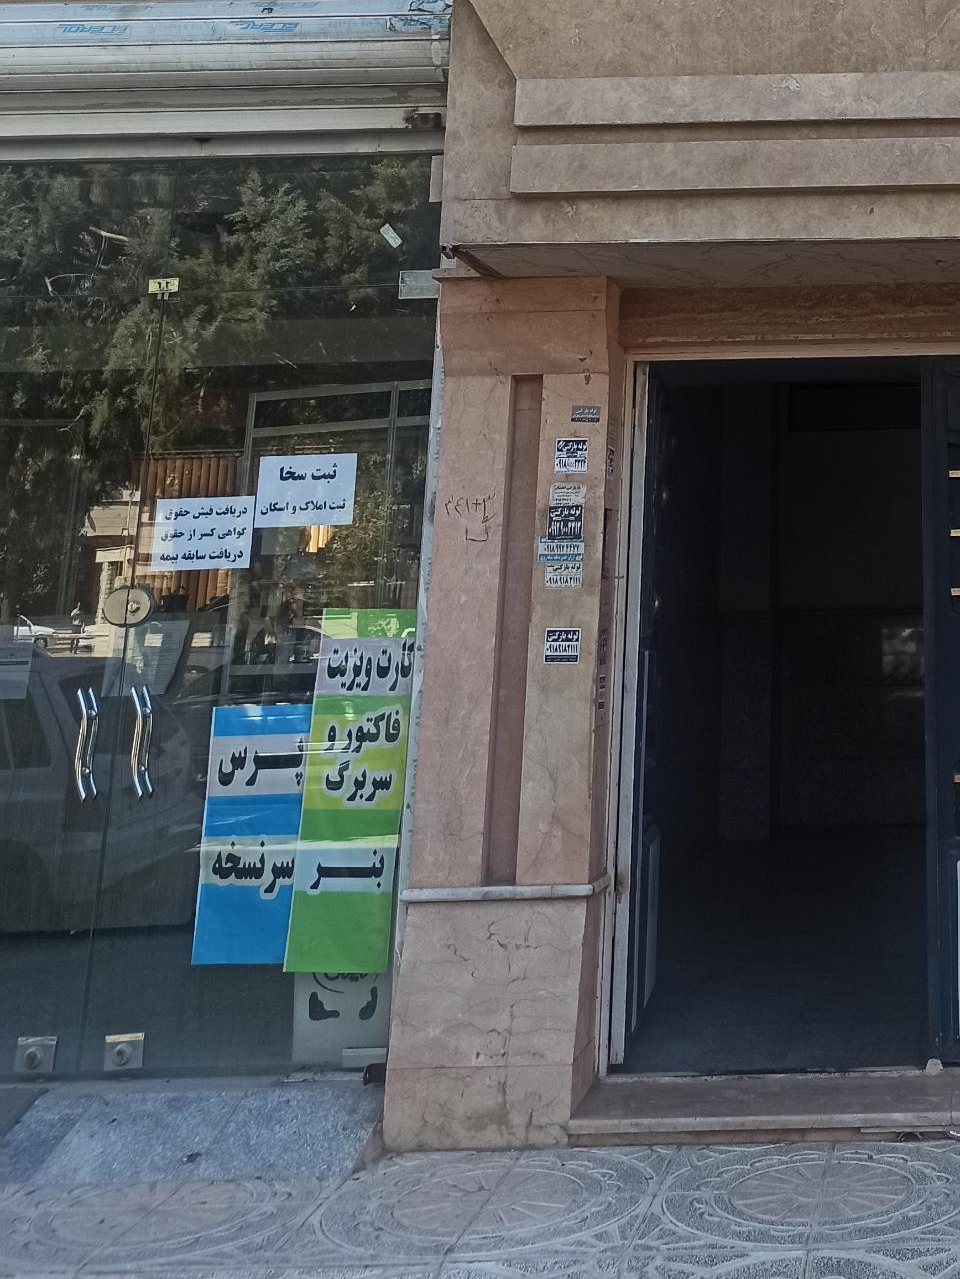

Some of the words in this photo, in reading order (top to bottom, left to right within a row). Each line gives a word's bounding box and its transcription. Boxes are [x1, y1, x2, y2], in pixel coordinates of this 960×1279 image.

[279, 465, 307, 482] سخا
[311, 462, 338, 484] ثبت
[192, 505, 214, 519] فیش
[215, 504, 248, 518] دریافت
[260, 501, 289, 516] اسکان
[290, 504, 297, 515] و
[299, 500, 327, 511] املاک
[328, 498, 347, 512] ثبت
[164, 507, 191, 521] حقوق
[160, 528, 185, 542] حقوق
[187, 527, 196, 541] از
[197, 527, 216, 541] کسر
[159, 552, 179, 564] بیمه
[181, 549, 207, 563] سابقه
[208, 547, 244, 563] دریافت
[326, 647, 373, 691] ویزیت
[376, 639, 414, 691] کارت
[324, 724, 337, 751] و
[345, 709, 401, 754] فاکتور
[324, 759, 393, 802] سربرگ
[309, 849, 385, 889] بنر
